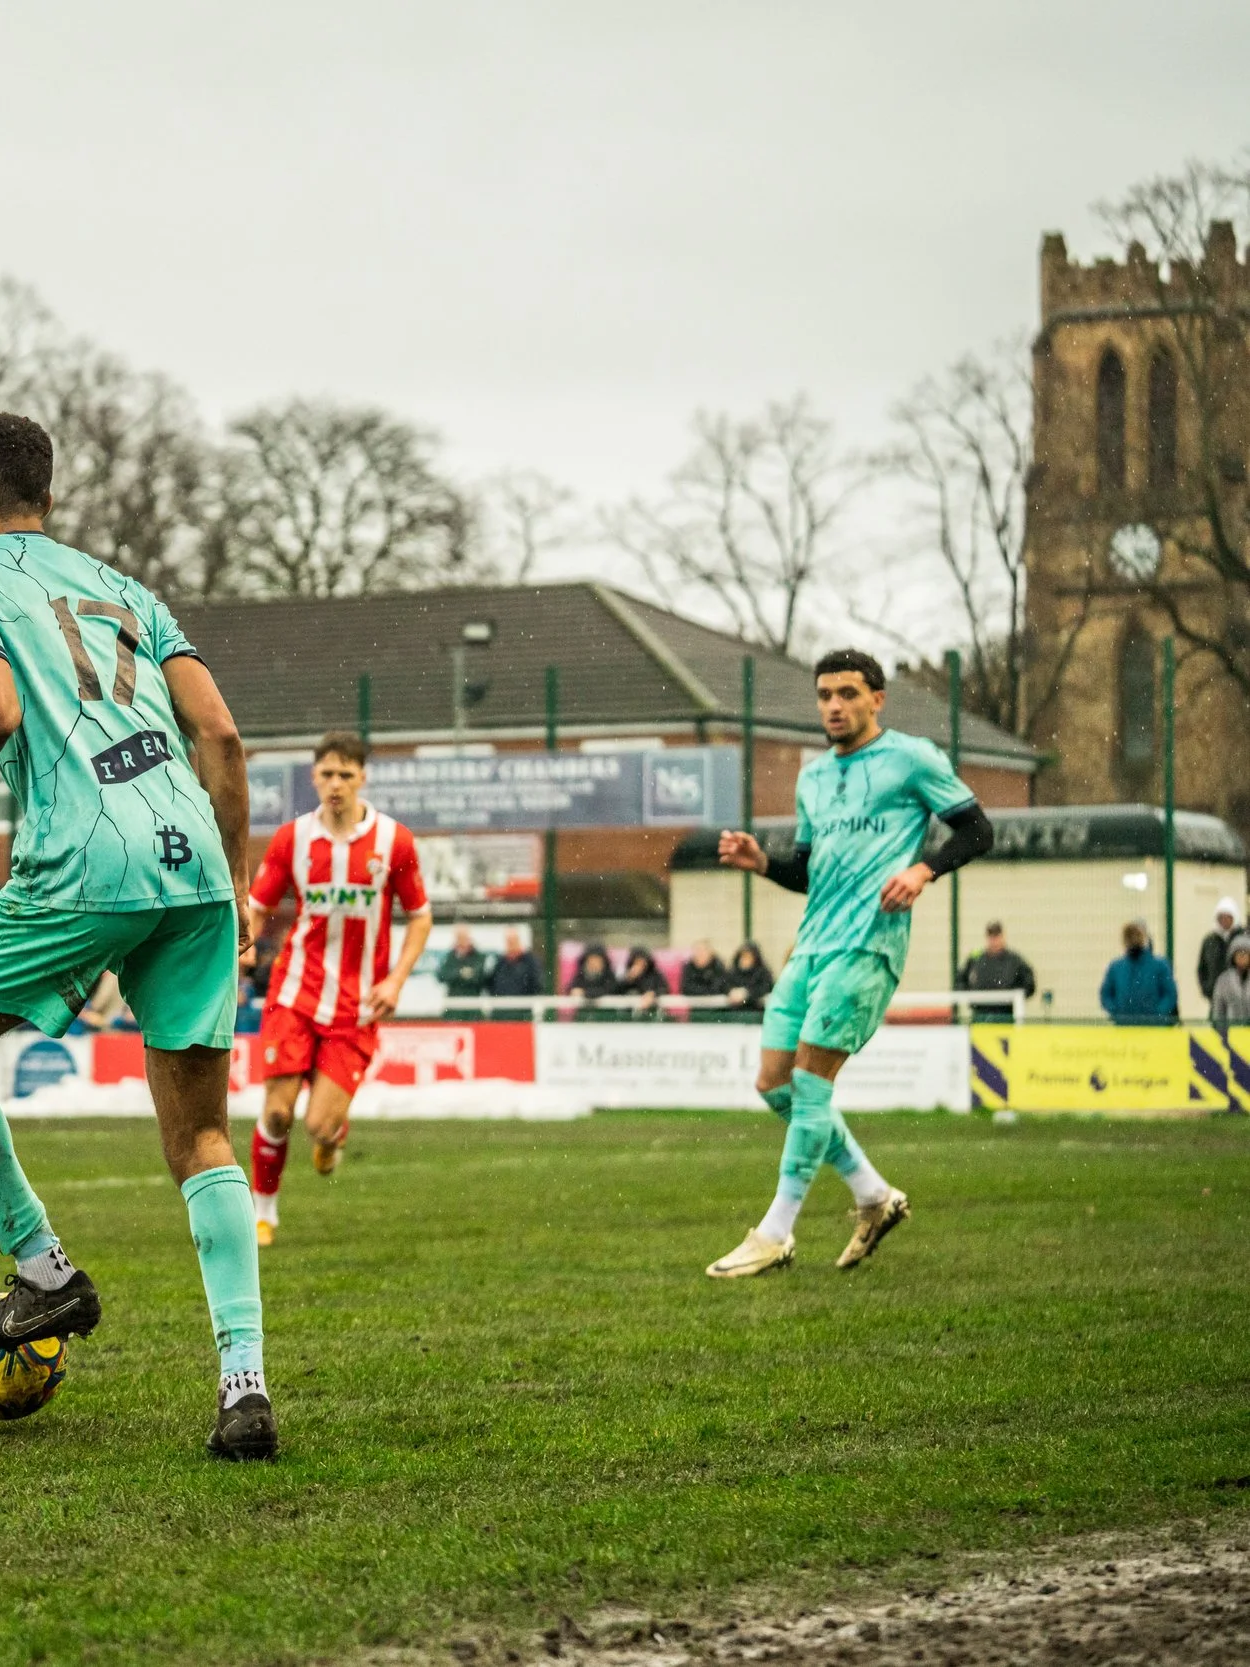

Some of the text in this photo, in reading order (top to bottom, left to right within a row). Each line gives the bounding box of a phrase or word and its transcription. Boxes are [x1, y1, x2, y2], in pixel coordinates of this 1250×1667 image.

[48, 596, 139, 706] 17
[100, 736, 166, 779] IREN
[305, 887, 377, 907] MINT
